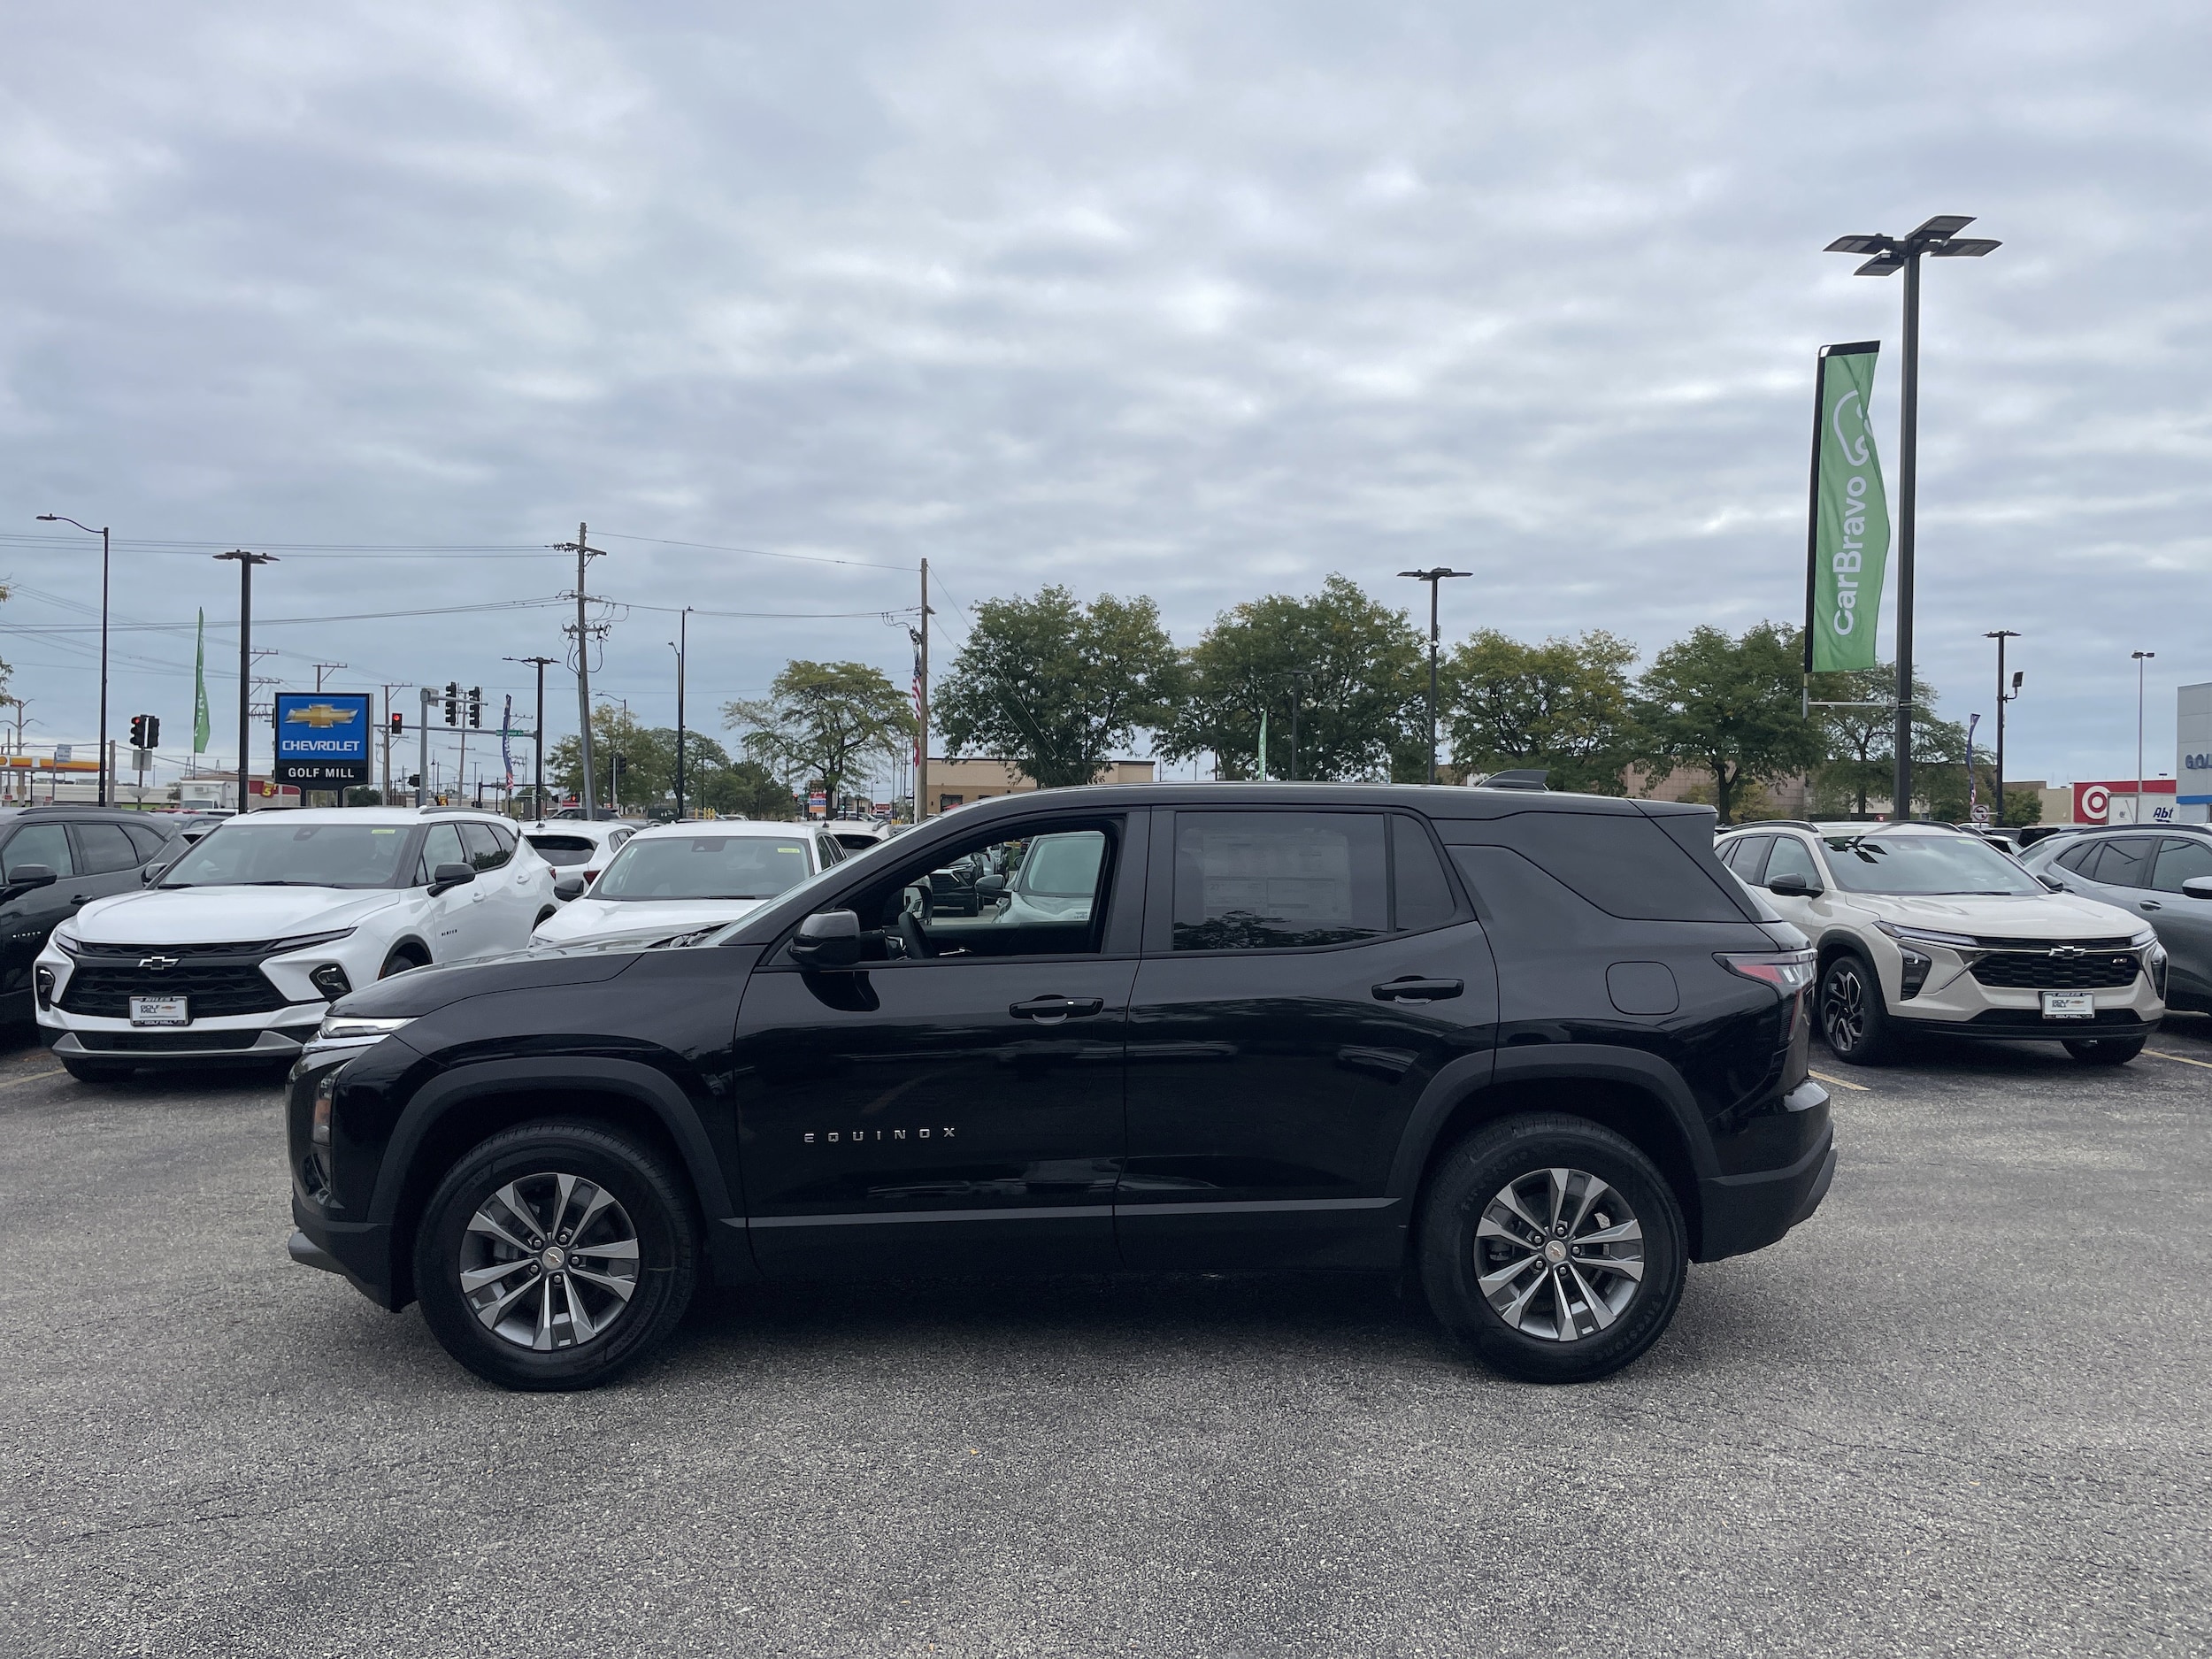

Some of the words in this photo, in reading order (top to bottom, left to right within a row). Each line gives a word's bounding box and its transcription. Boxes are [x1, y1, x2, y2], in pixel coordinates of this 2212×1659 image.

[1832, 476, 1867, 636] CarBravo
[281, 740, 360, 752] CHEVROLET
[288, 767, 320, 778] GOLF
[325, 767, 355, 778] MILL
[2153, 807, 2174, 818] Abt
[803, 1127, 956, 1142] EQUINOX
